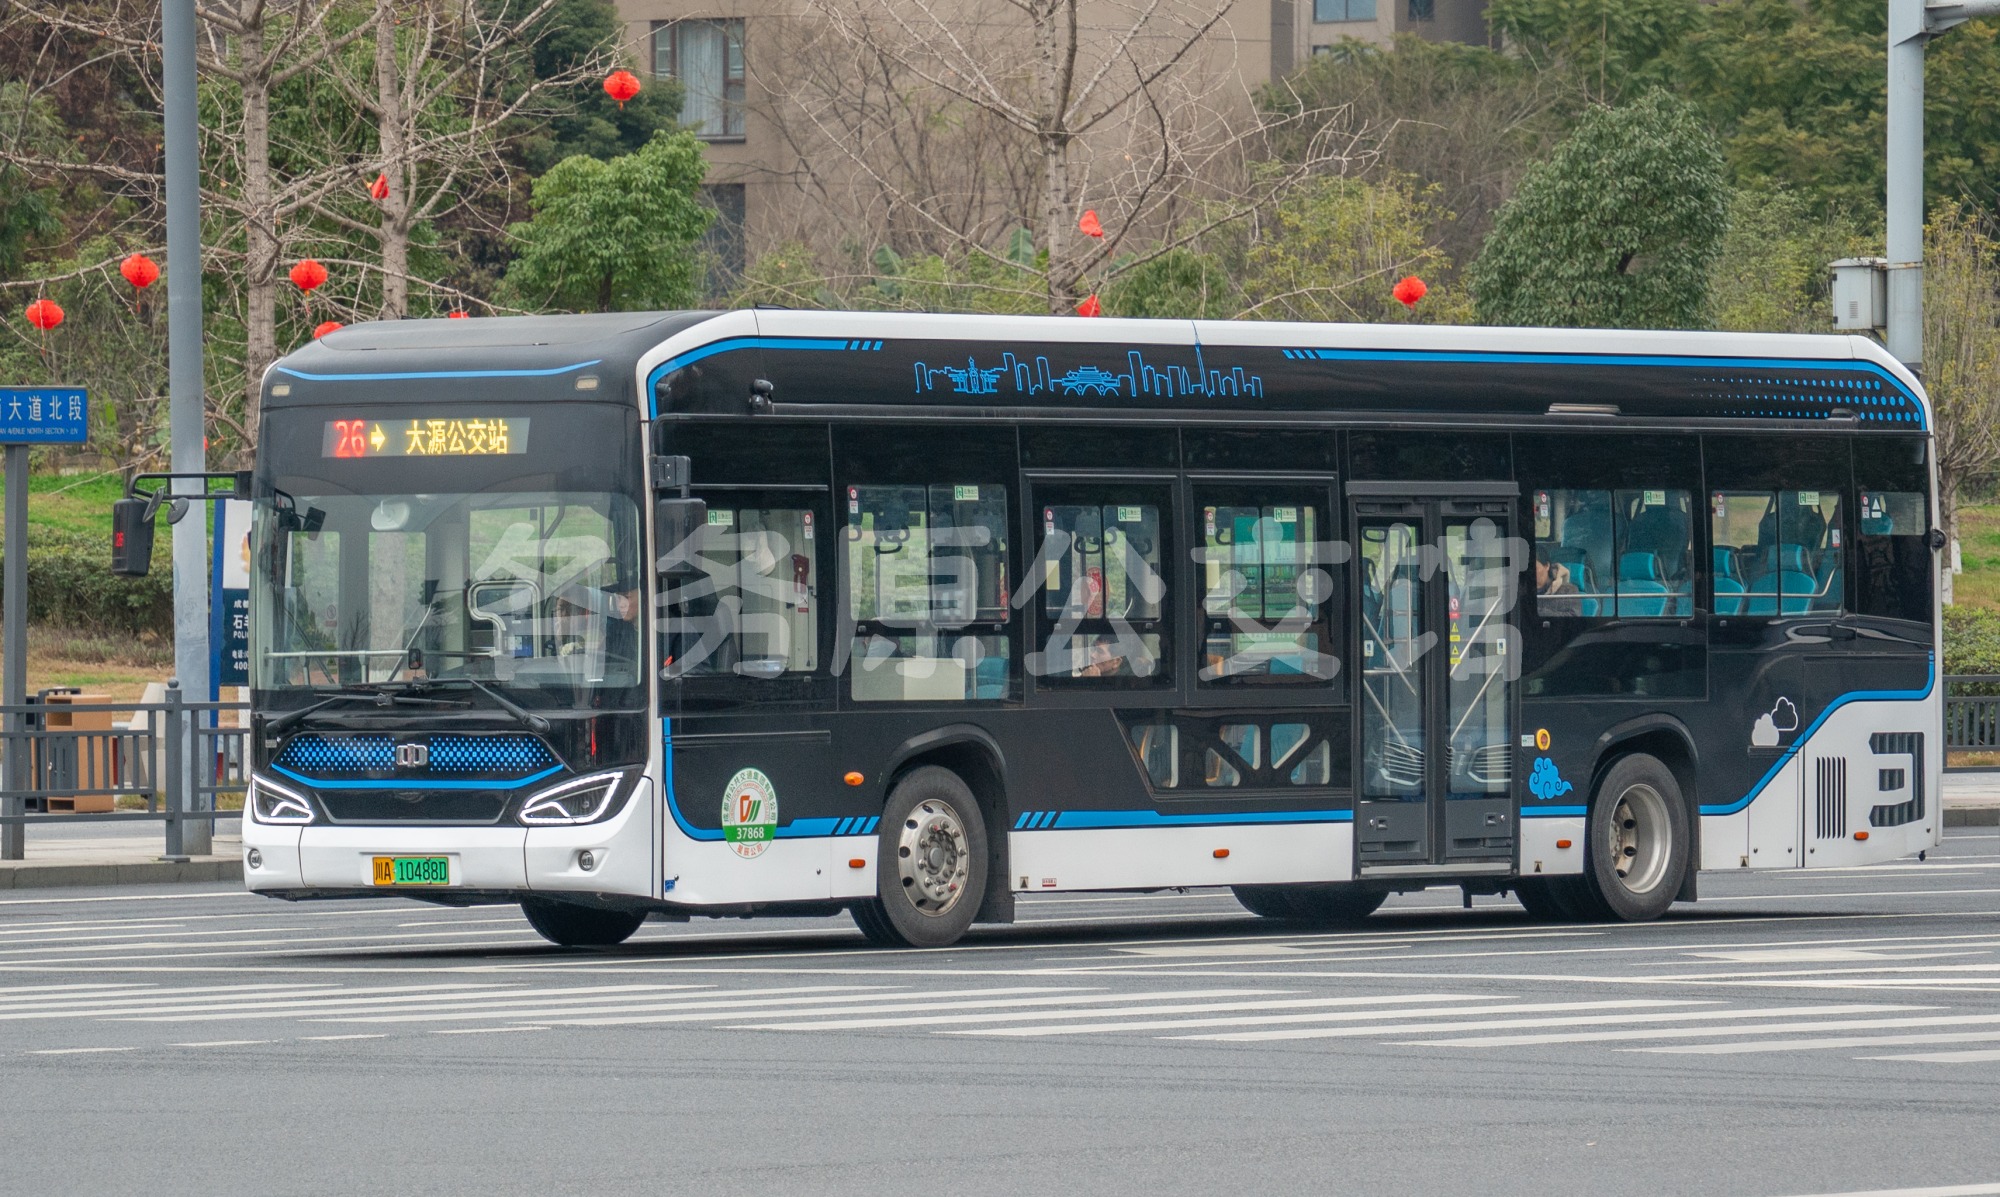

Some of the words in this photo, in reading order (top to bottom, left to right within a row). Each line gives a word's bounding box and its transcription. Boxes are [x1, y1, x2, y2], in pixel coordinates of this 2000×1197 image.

[0, 395, 82, 421] 大道北段
[27, 427, 43, 435] NORTH
[45, 427, 64, 435] SECTION
[335, 420, 366, 458] 26
[406, 419, 508, 455] 大源公交站
[233, 662, 249, 670] 400
[736, 827, 765, 840] 37868
